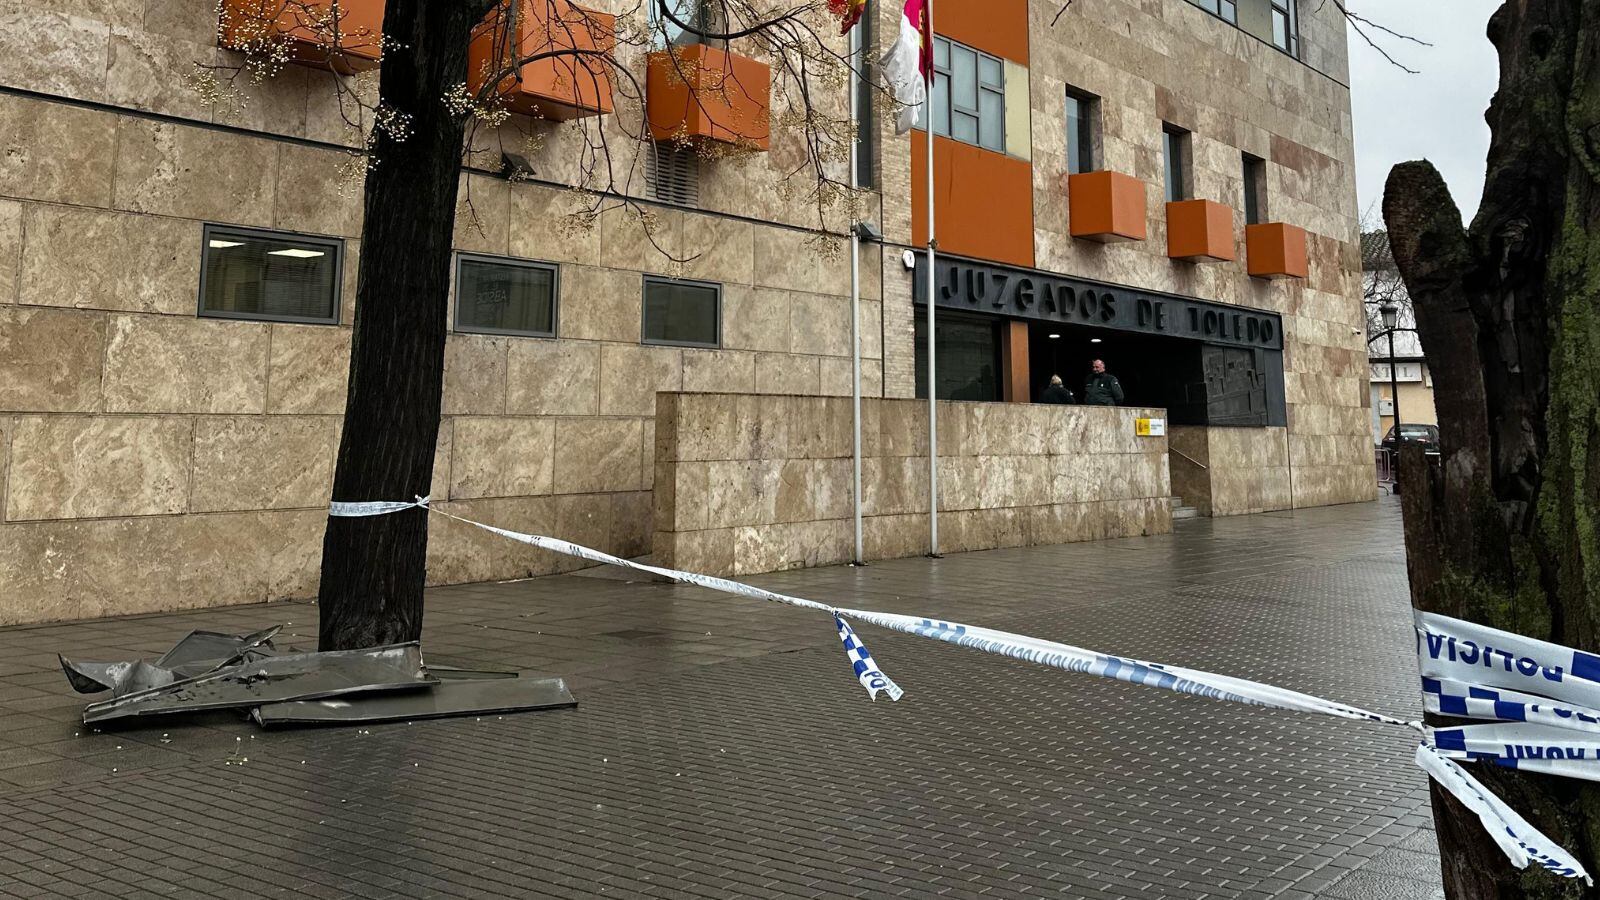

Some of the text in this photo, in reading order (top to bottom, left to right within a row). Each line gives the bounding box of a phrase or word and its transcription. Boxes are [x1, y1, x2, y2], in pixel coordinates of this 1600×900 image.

[941, 266, 1274, 344] JUZGADOS DE TOLEDO
